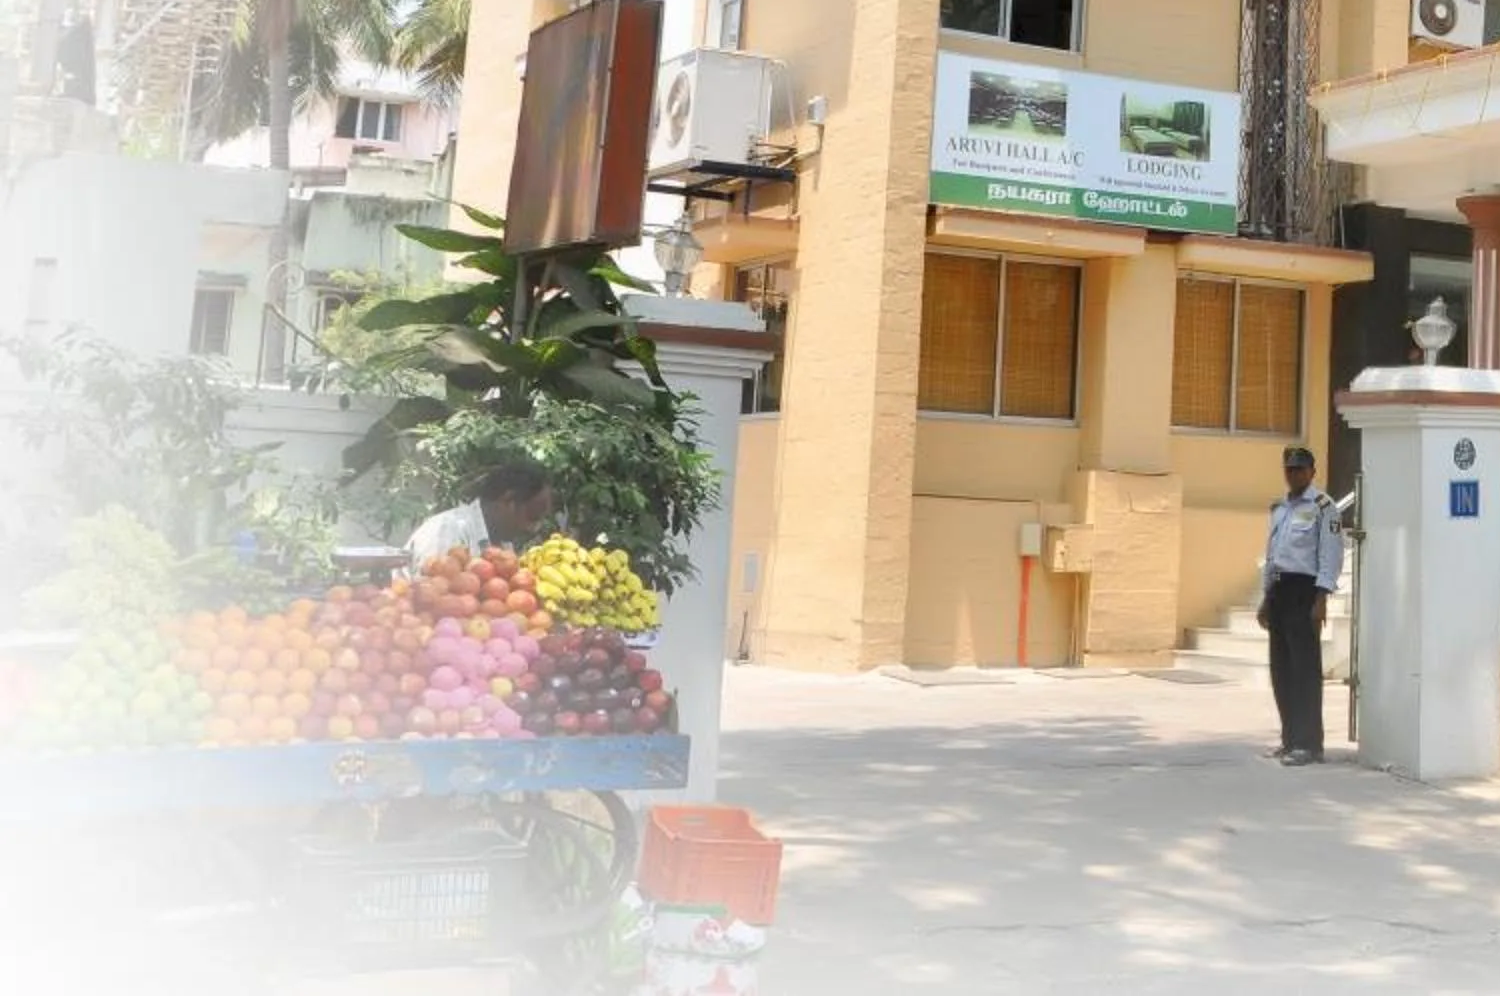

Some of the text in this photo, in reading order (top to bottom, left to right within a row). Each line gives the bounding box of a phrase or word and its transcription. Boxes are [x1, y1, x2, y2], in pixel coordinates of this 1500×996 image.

[946, 136, 1086, 167] ARUVI HALL A/C
[1126, 157, 1202, 180] LODGING
[1456, 485, 1474, 513] IN
